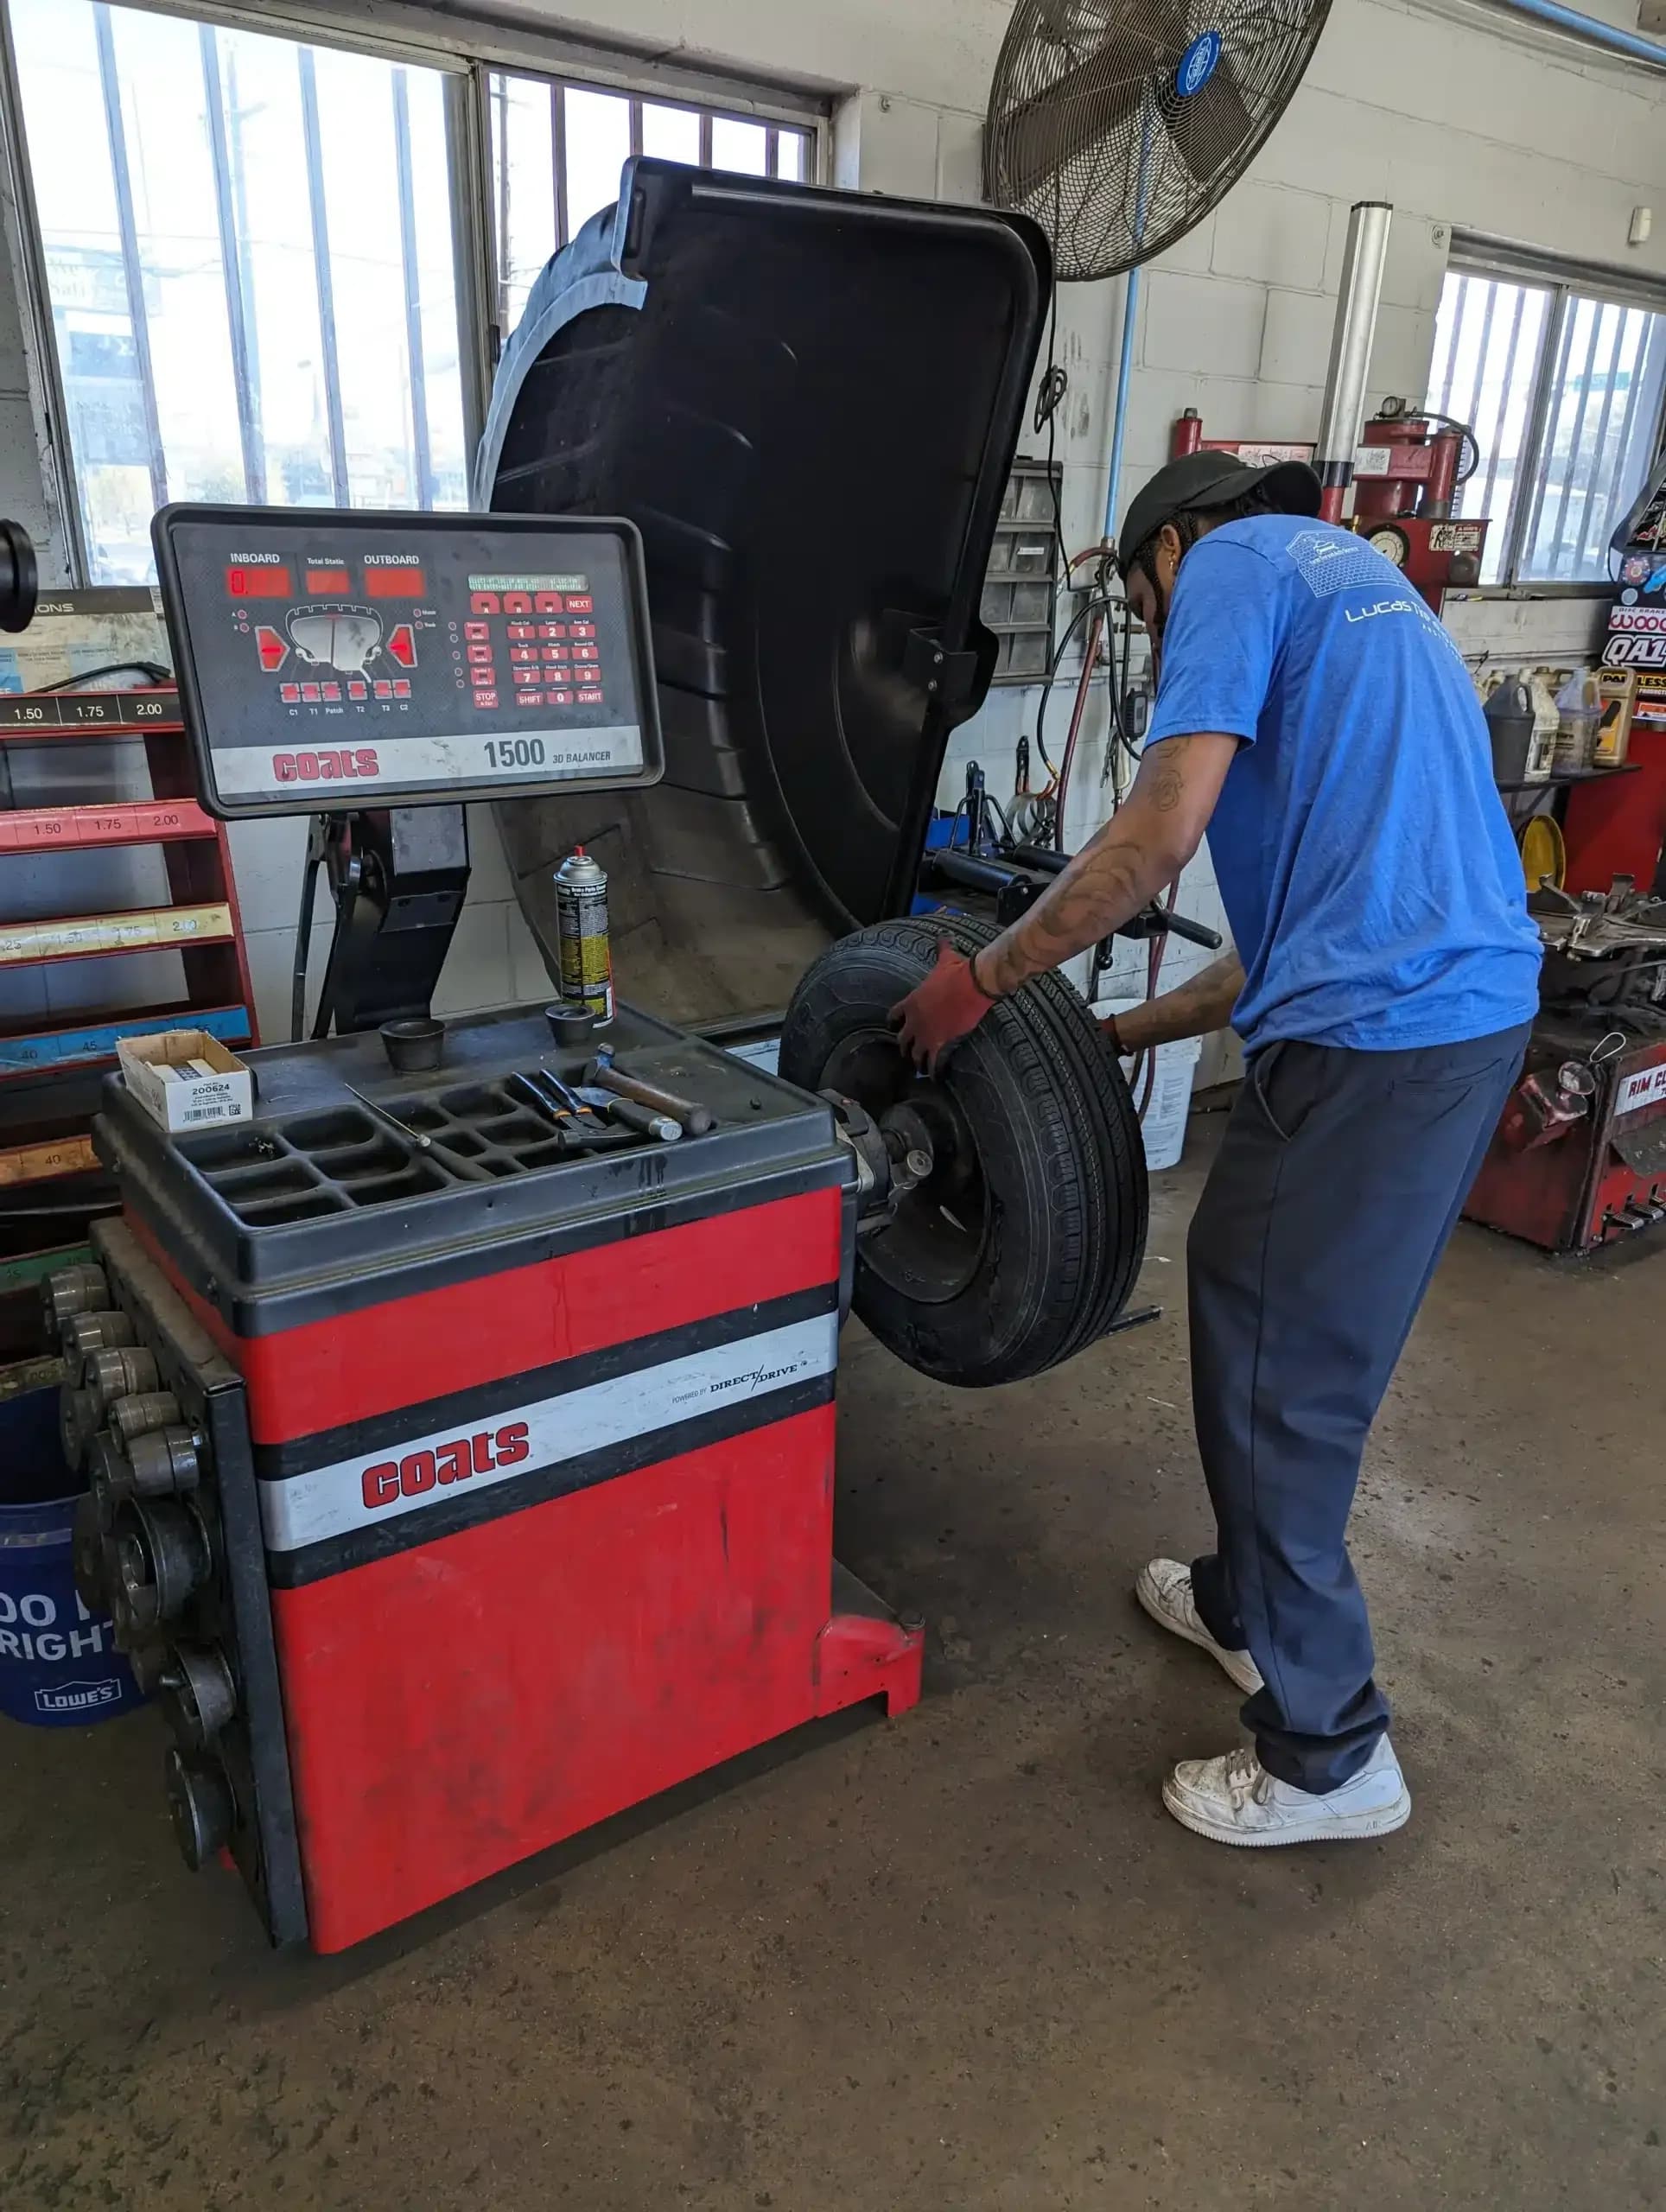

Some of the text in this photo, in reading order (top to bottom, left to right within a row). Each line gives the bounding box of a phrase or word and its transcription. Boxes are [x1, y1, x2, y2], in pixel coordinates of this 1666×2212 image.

[231, 553, 280, 563] INBOARD
[364, 555, 419, 565] OUTBOARD
[518, 628, 525, 637] 1
[549, 627, 556, 636] 2
[579, 627, 586, 636] 3
[521, 651, 529, 660] 4
[551, 650, 559, 658] 5
[582, 649, 588, 658] 6
[524, 673, 531, 683] 7
[554, 672, 562, 682] 8
[584, 671, 591, 681] 9
[475, 692, 495, 701] STOP
[519, 695, 541, 704] SHIFT
[557, 693, 563, 702] 0
[579, 692, 601, 701] START
[14, 704, 162, 720] 1.50 1.75 2.00
[483, 738, 611, 768] 1500 3D BALANCER
[34, 815, 179, 836] 1.50 1.75 2.00
[173, 919, 198, 932] 2.00
[83, 1040, 98, 1052] 45
[192, 1084, 231, 1096] 200624
[1628, 1075, 1652, 1098] RIM
[45, 1154, 61, 1166] 40
[671, 1391, 698, 1404] POWERED
[698, 1387, 708, 1395] BY
[0, 1619, 114, 1662] RIGH
[42, 1687, 113, 1708] LOWE'S
